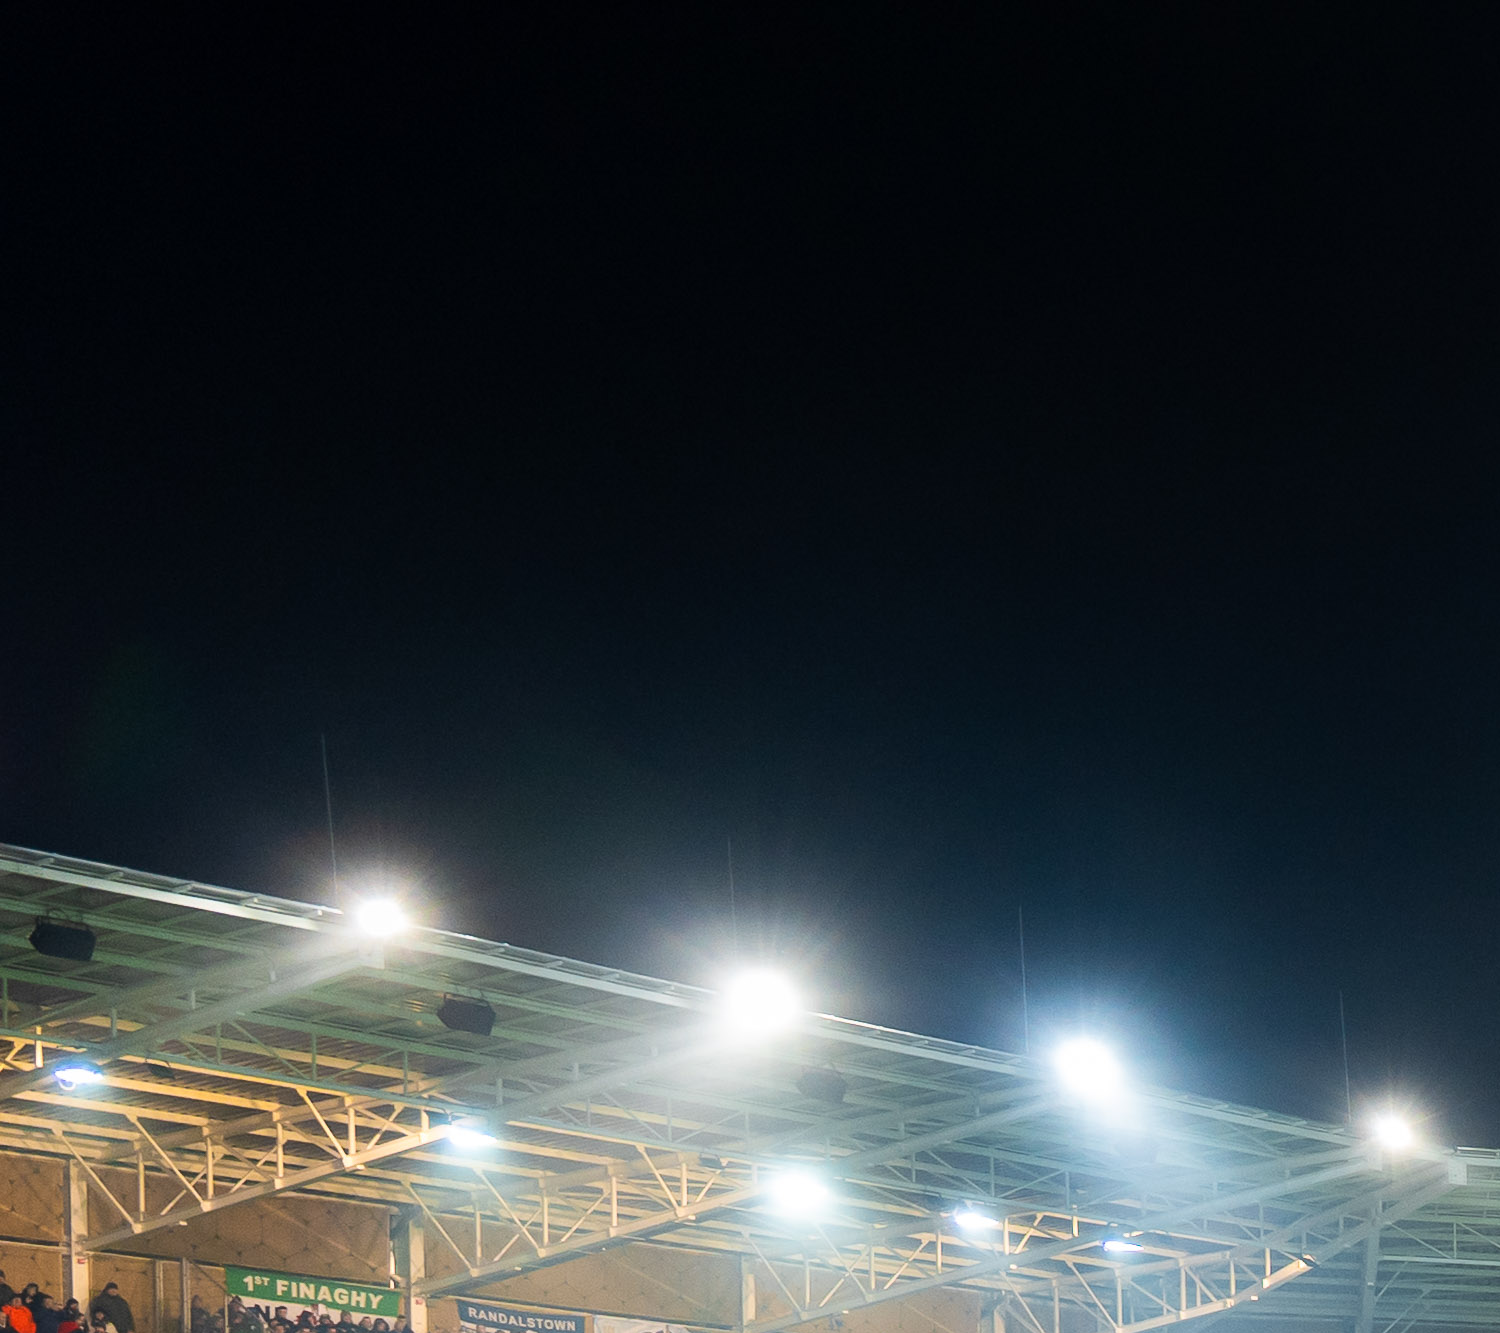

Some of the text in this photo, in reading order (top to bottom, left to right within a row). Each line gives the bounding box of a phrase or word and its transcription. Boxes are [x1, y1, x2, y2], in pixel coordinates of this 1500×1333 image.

[242, 1275, 383, 1310] 1ST FINAGHY
[468, 1306, 576, 1332] RANDALSTOWN
